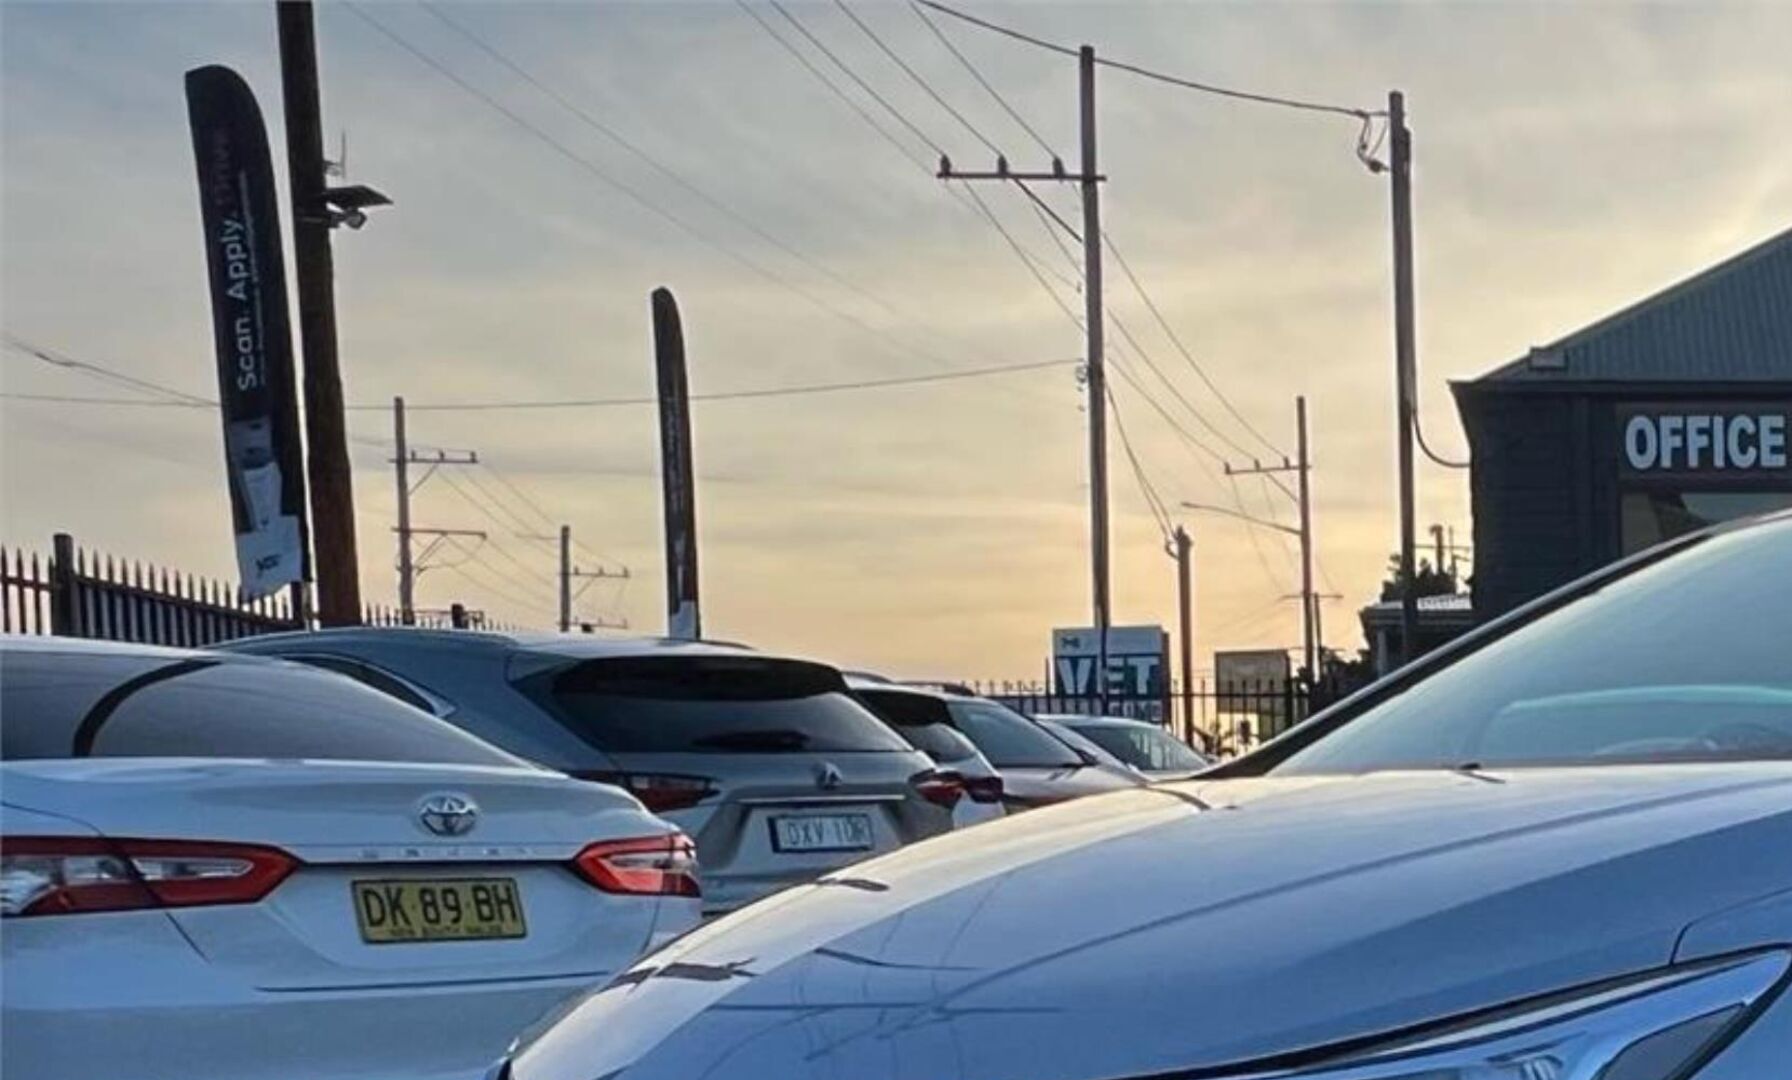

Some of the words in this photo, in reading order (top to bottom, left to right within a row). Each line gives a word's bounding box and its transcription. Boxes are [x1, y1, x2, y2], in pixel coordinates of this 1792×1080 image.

[219, 211, 248, 301] Apply.
[1625, 414, 1787, 470] OFFICE
[1056, 657, 1160, 695] VET
[361, 887, 412, 927] DK
[419, 886, 463, 925] 89
[471, 884, 518, 923] BH
